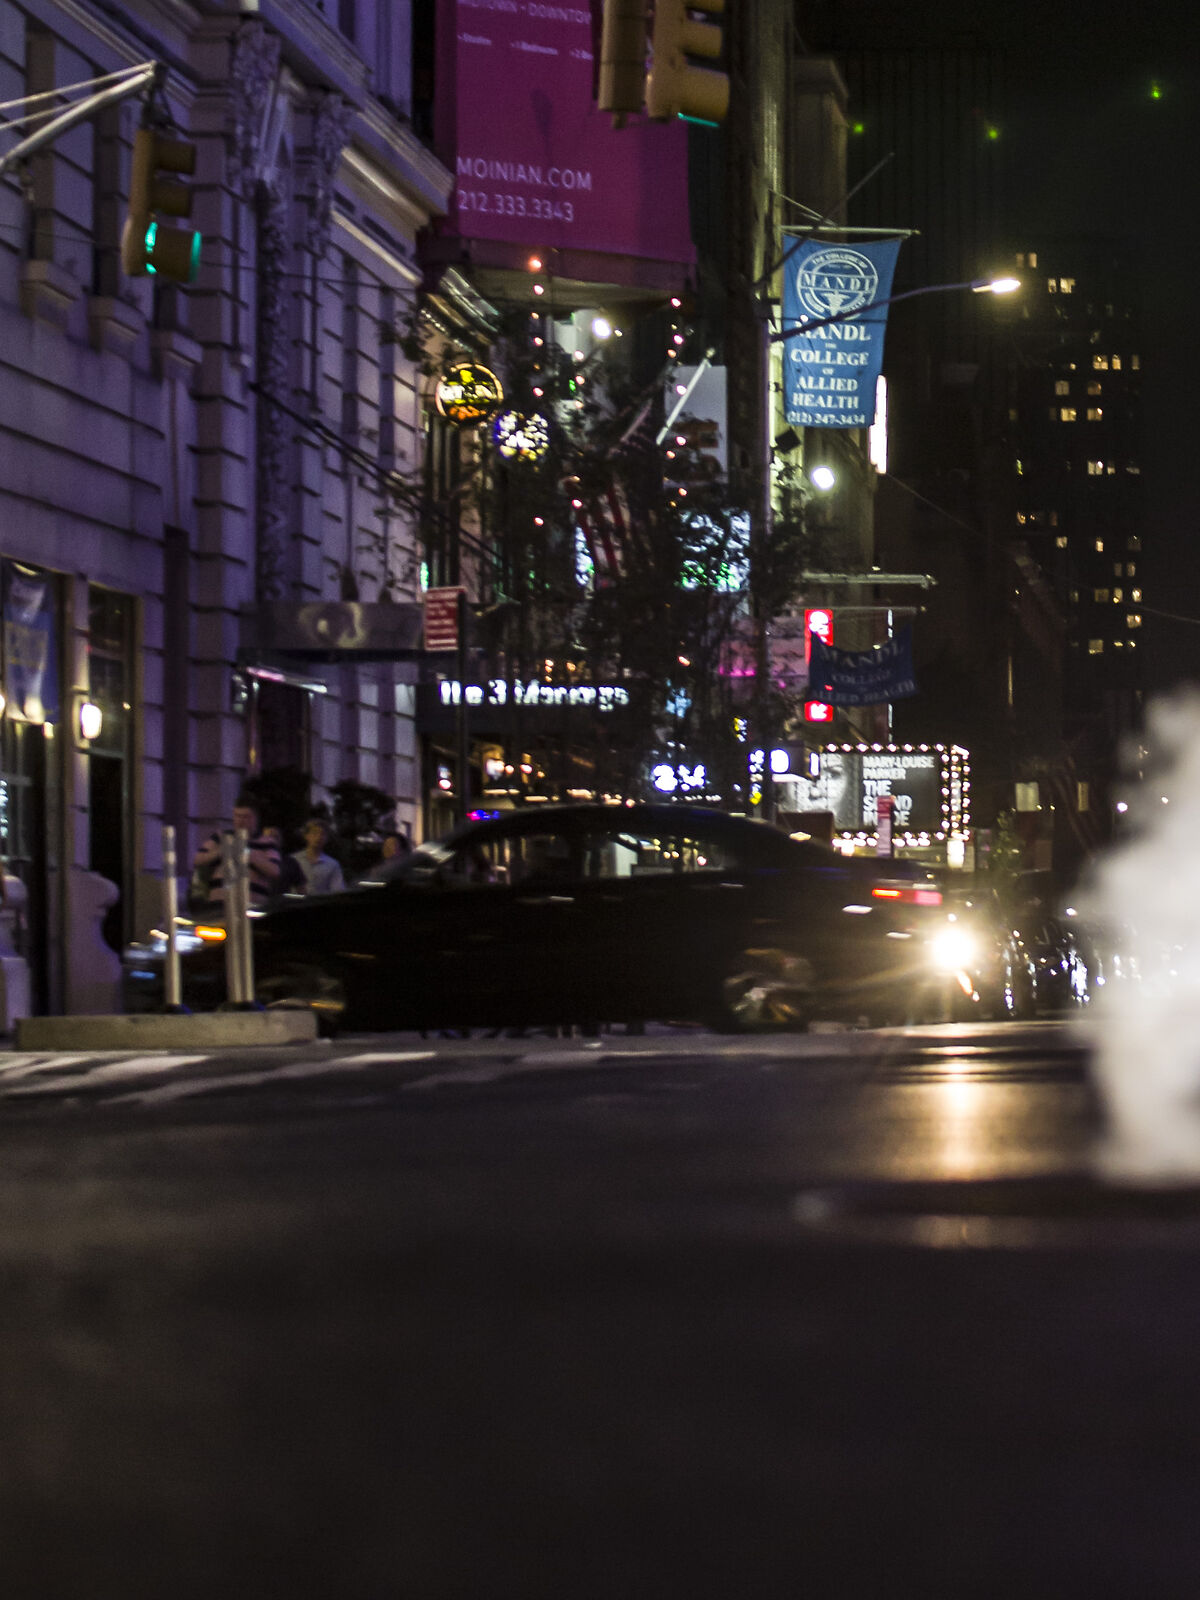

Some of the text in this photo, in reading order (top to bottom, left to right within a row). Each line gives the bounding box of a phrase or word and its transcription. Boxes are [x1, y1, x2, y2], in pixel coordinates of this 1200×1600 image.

[457, 156, 592, 190] MOINIAN.COM
[458, 189, 574, 223] 212.333.3343
[804, 272, 873, 293] MANDL
[790, 349, 870, 366] COLLEGE
[797, 376, 858, 392] ALLIED
[792, 392, 859, 409] HEALTH
[862, 755, 935, 769] MARY-LOUISE
[862, 768, 907, 780] PARKER
[862, 780, 893, 797] THE
